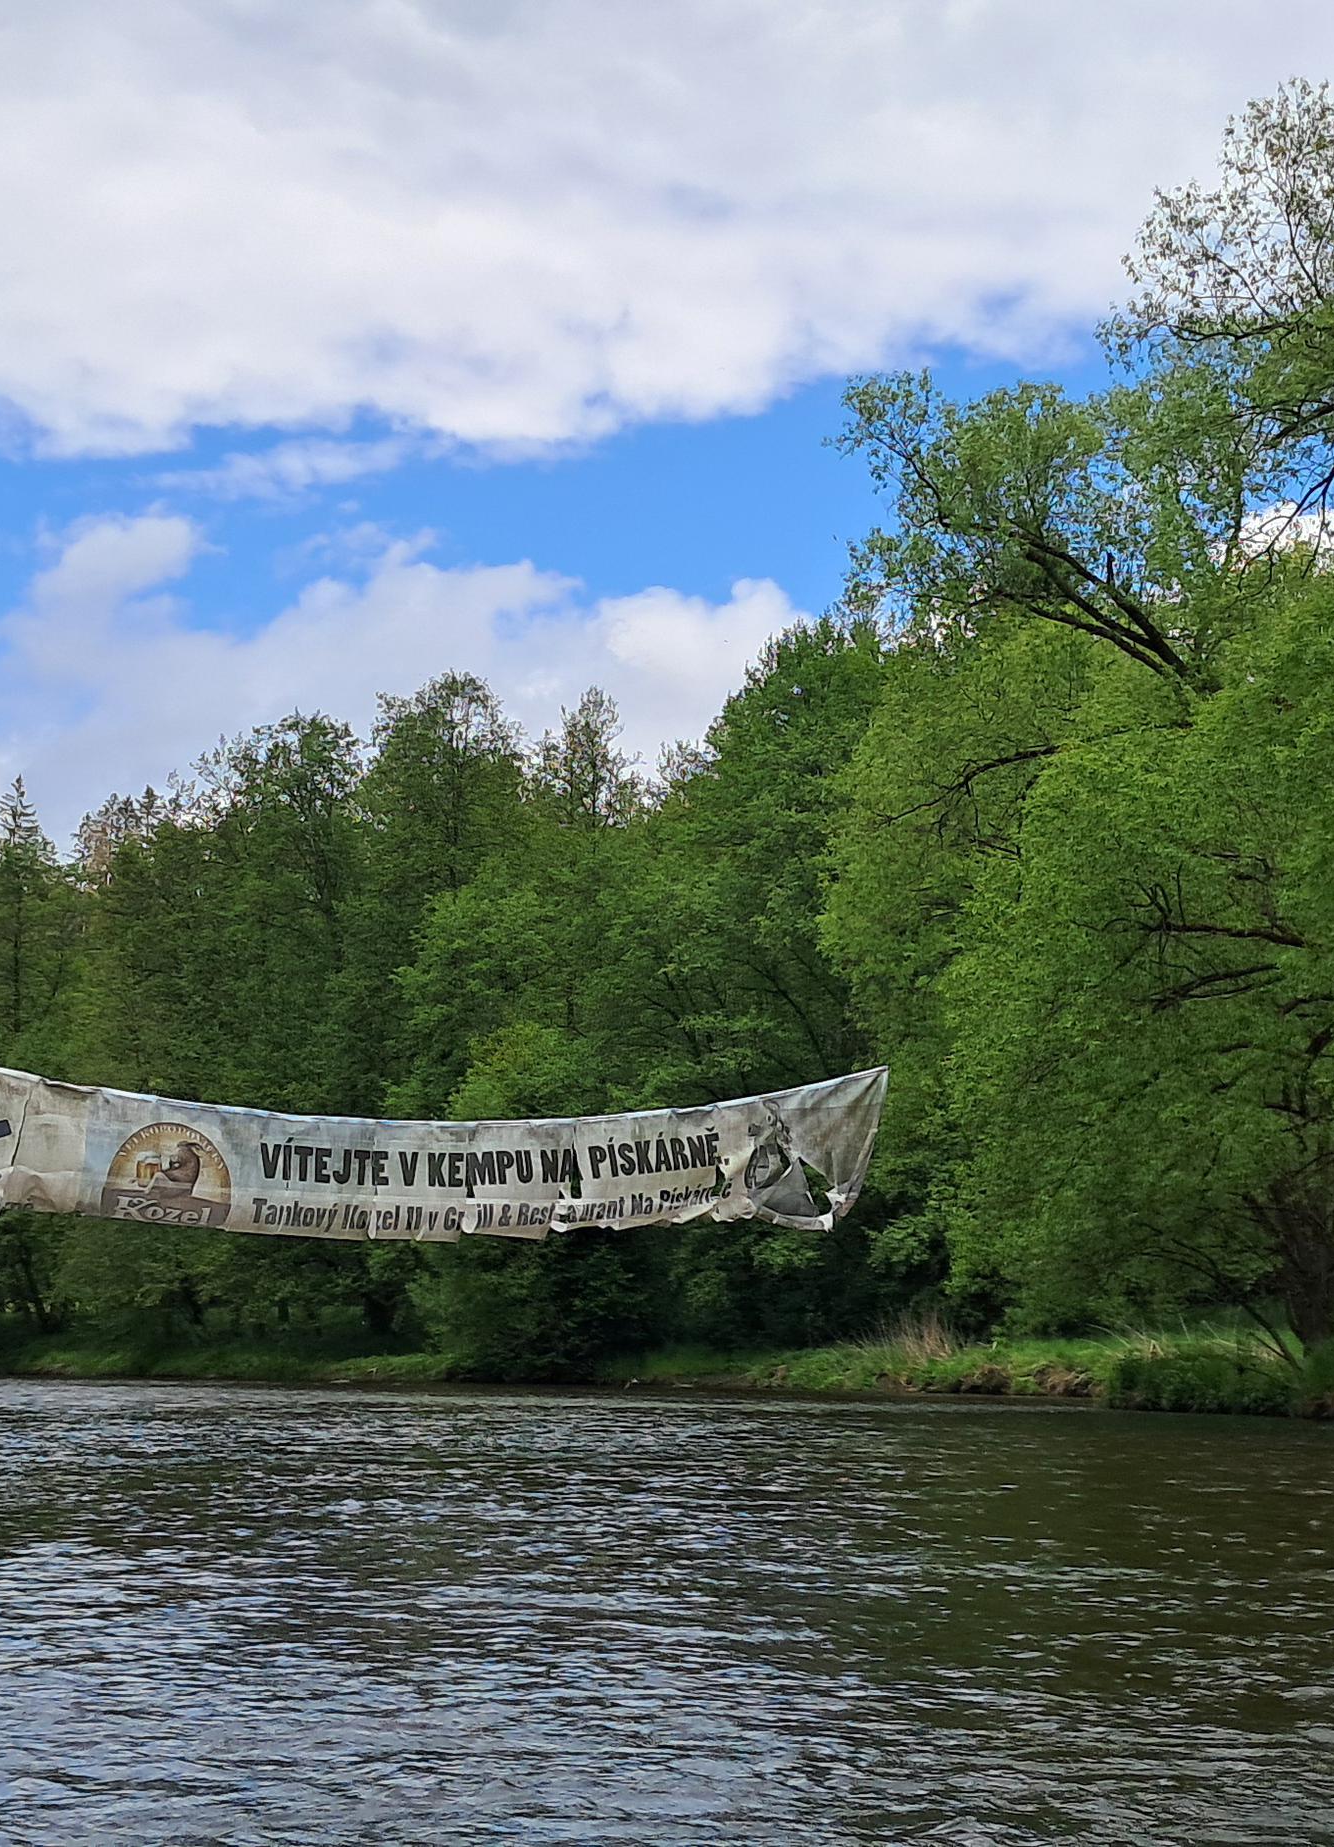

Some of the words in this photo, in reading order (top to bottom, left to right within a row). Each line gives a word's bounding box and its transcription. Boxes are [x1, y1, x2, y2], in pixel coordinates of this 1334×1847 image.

[259, 1136, 390, 1186] VÍTEJTE
[398, 1151, 419, 1187] V
[427, 1149, 534, 1188] KEMPU
[540, 1148, 584, 1184] NA
[112, 1195, 212, 1225] Kozel
[252, 1197, 338, 1233] Tankový
[428, 1210, 440, 1231] v
[497, 1203, 513, 1227] &
[630, 1192, 654, 1217] Na
